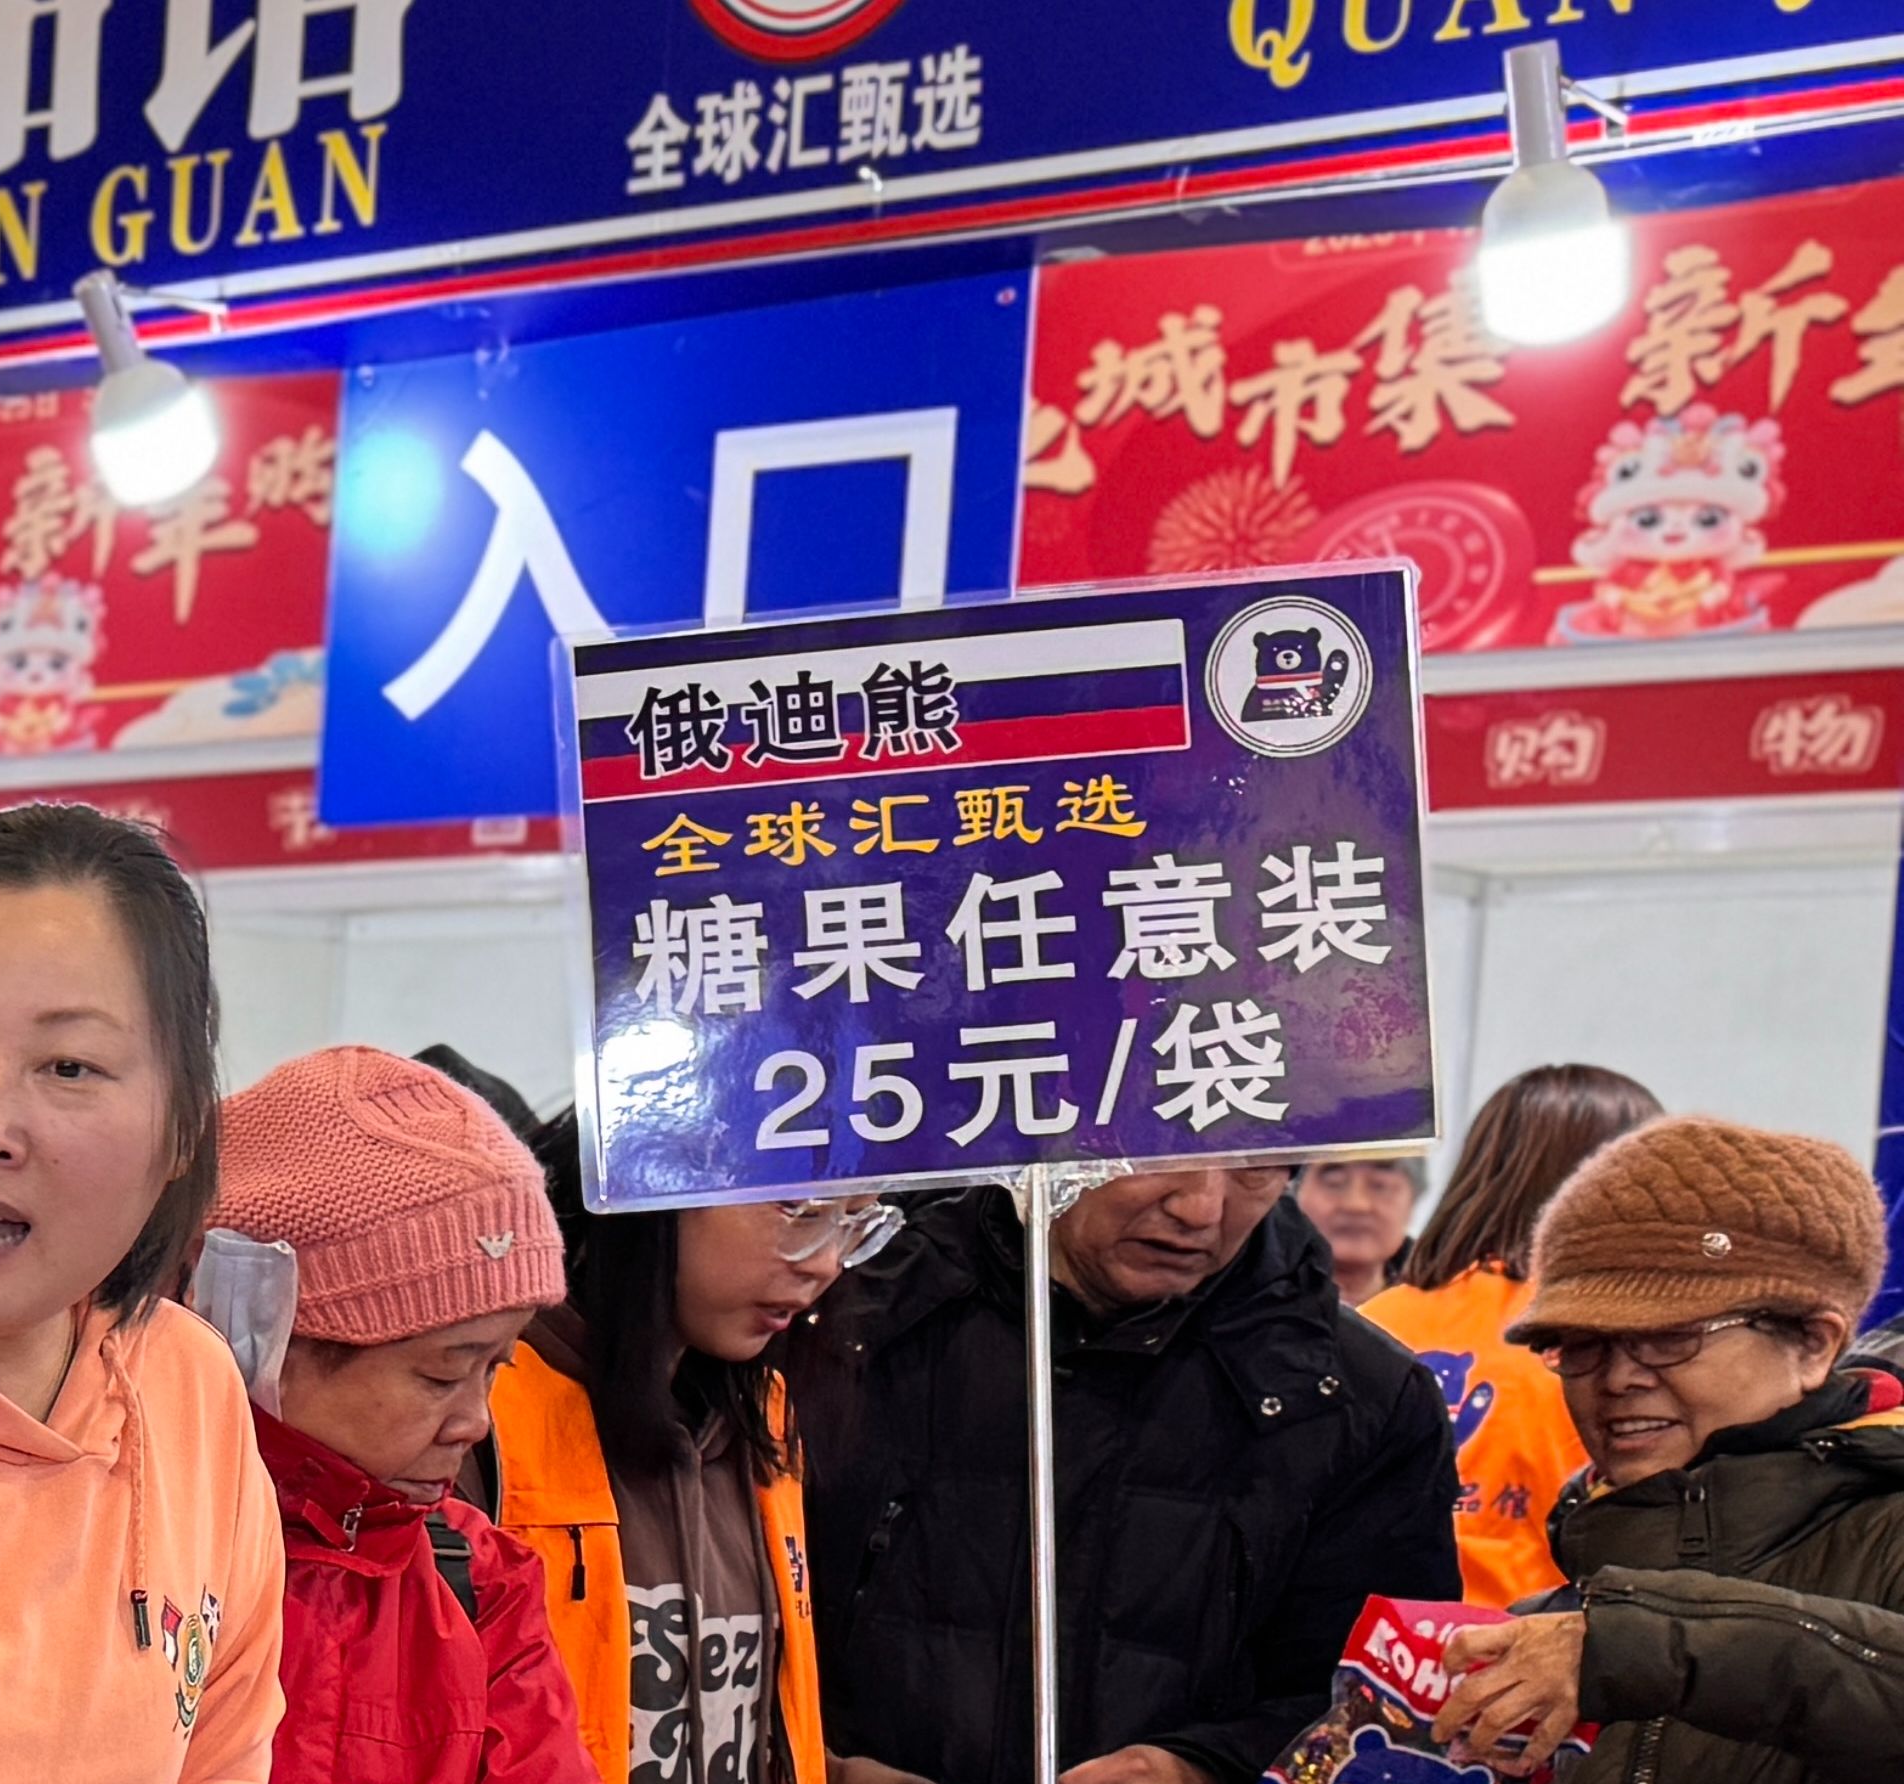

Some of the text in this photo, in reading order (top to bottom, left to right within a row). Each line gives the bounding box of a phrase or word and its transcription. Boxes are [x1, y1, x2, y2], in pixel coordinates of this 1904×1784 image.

[625, 43, 982, 195] 全球汇甄选
[89, 123, 389, 268] GUAN
[382, 407, 959, 721] 入口
[626, 659, 962, 782] 俄迪熊
[641, 773, 1148, 878] 全球汇甄选
[630, 841, 1393, 1017] 糖果任意装
[753, 998, 1291, 1152] 25元/袋
